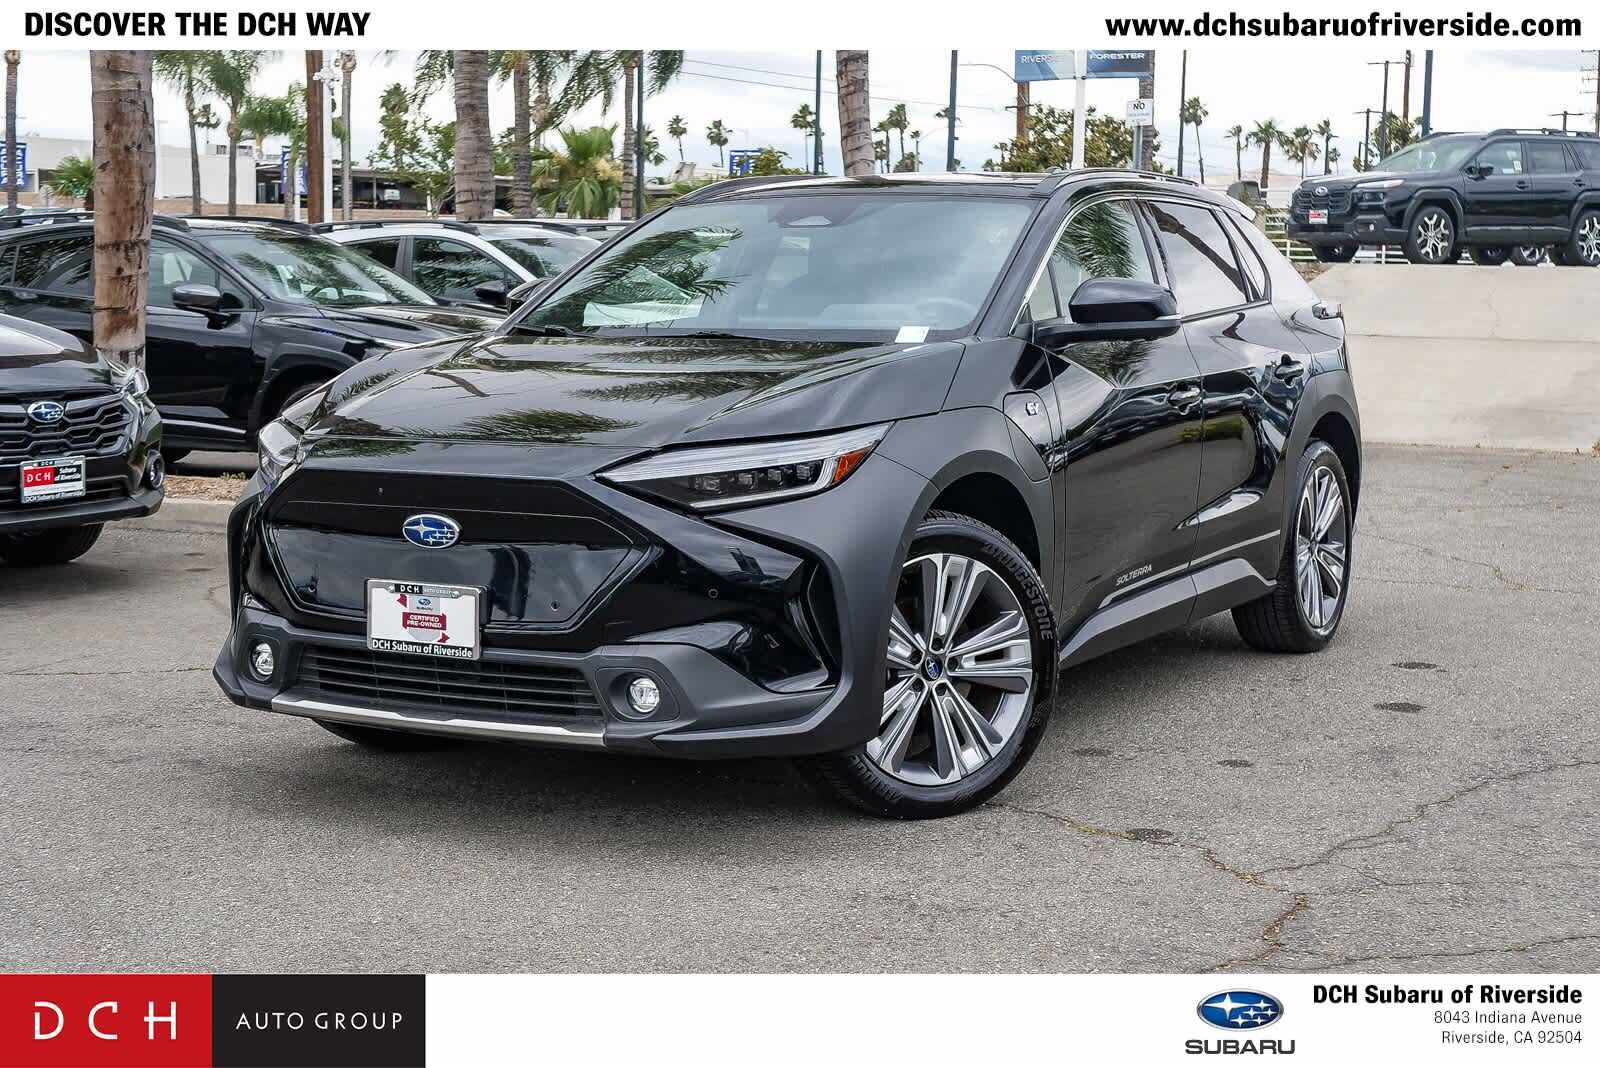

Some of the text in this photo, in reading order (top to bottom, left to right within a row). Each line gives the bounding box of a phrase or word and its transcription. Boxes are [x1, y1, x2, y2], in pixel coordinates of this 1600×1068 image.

[1089, 52, 1145, 60] FORESTER
[1133, 102, 1145, 110] NO
[26, 472, 52, 483] DCH
[1115, 563, 1152, 587] SOLTERRA
[400, 584, 421, 593] DCH
[409, 614, 440, 623] CERTIFIED
[406, 619, 442, 628] PRE-OWNED
[372, 639, 473, 658] DCH Subaru of Riverside
